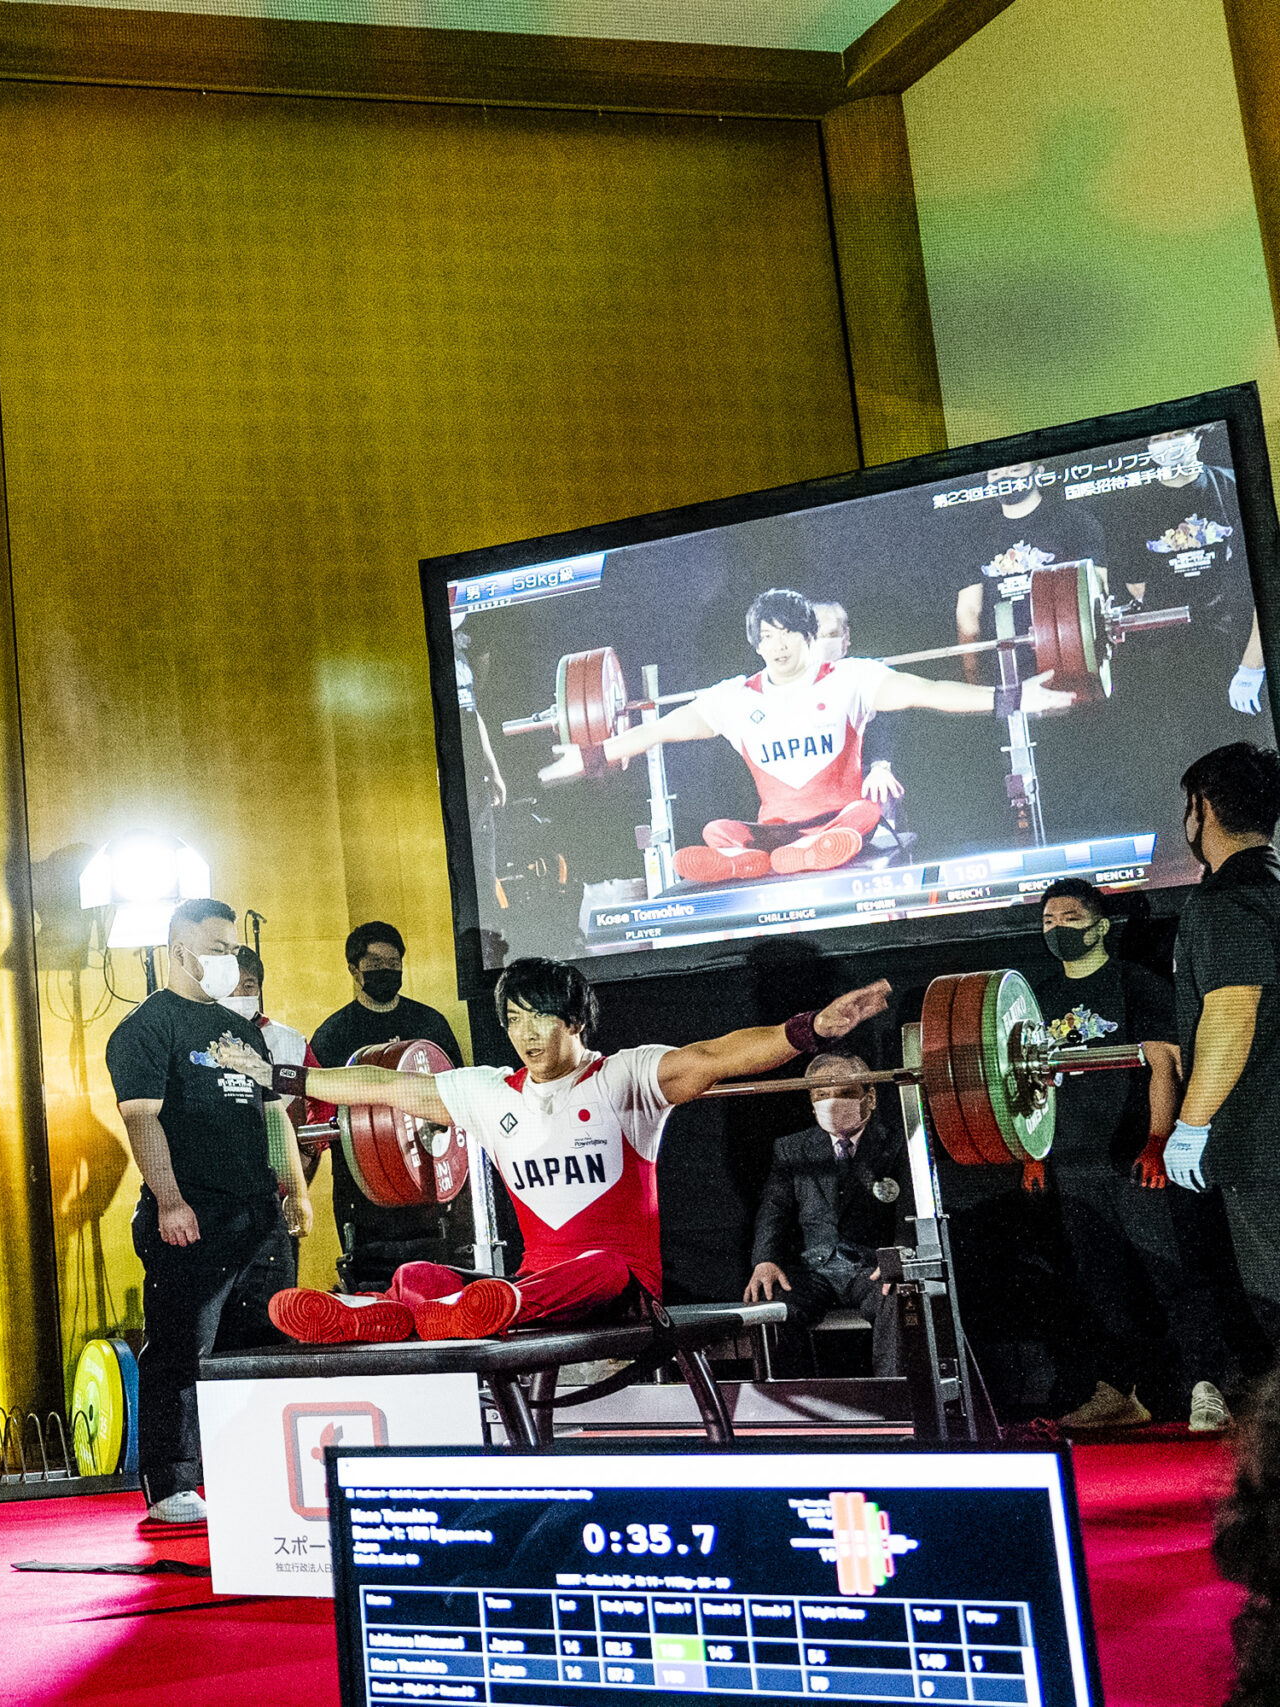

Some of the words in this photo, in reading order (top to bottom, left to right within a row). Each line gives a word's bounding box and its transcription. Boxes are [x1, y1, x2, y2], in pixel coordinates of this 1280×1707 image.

[761, 733, 833, 764] JAPAN
[1096, 869, 1134, 883] BENCH
[1137, 867, 1145, 878] 3
[947, 888, 983, 901] BENCH
[596, 913, 630, 927] Kose
[631, 902, 695, 923] Tomohiro
[757, 908, 817, 924] CHALLENGE
[625, 927, 661, 940] PLAYER
[512, 1153, 606, 1190] JAPAN
[273, 1535, 332, 1556] スポー
[582, 1522, 716, 1554] 0:35.7
